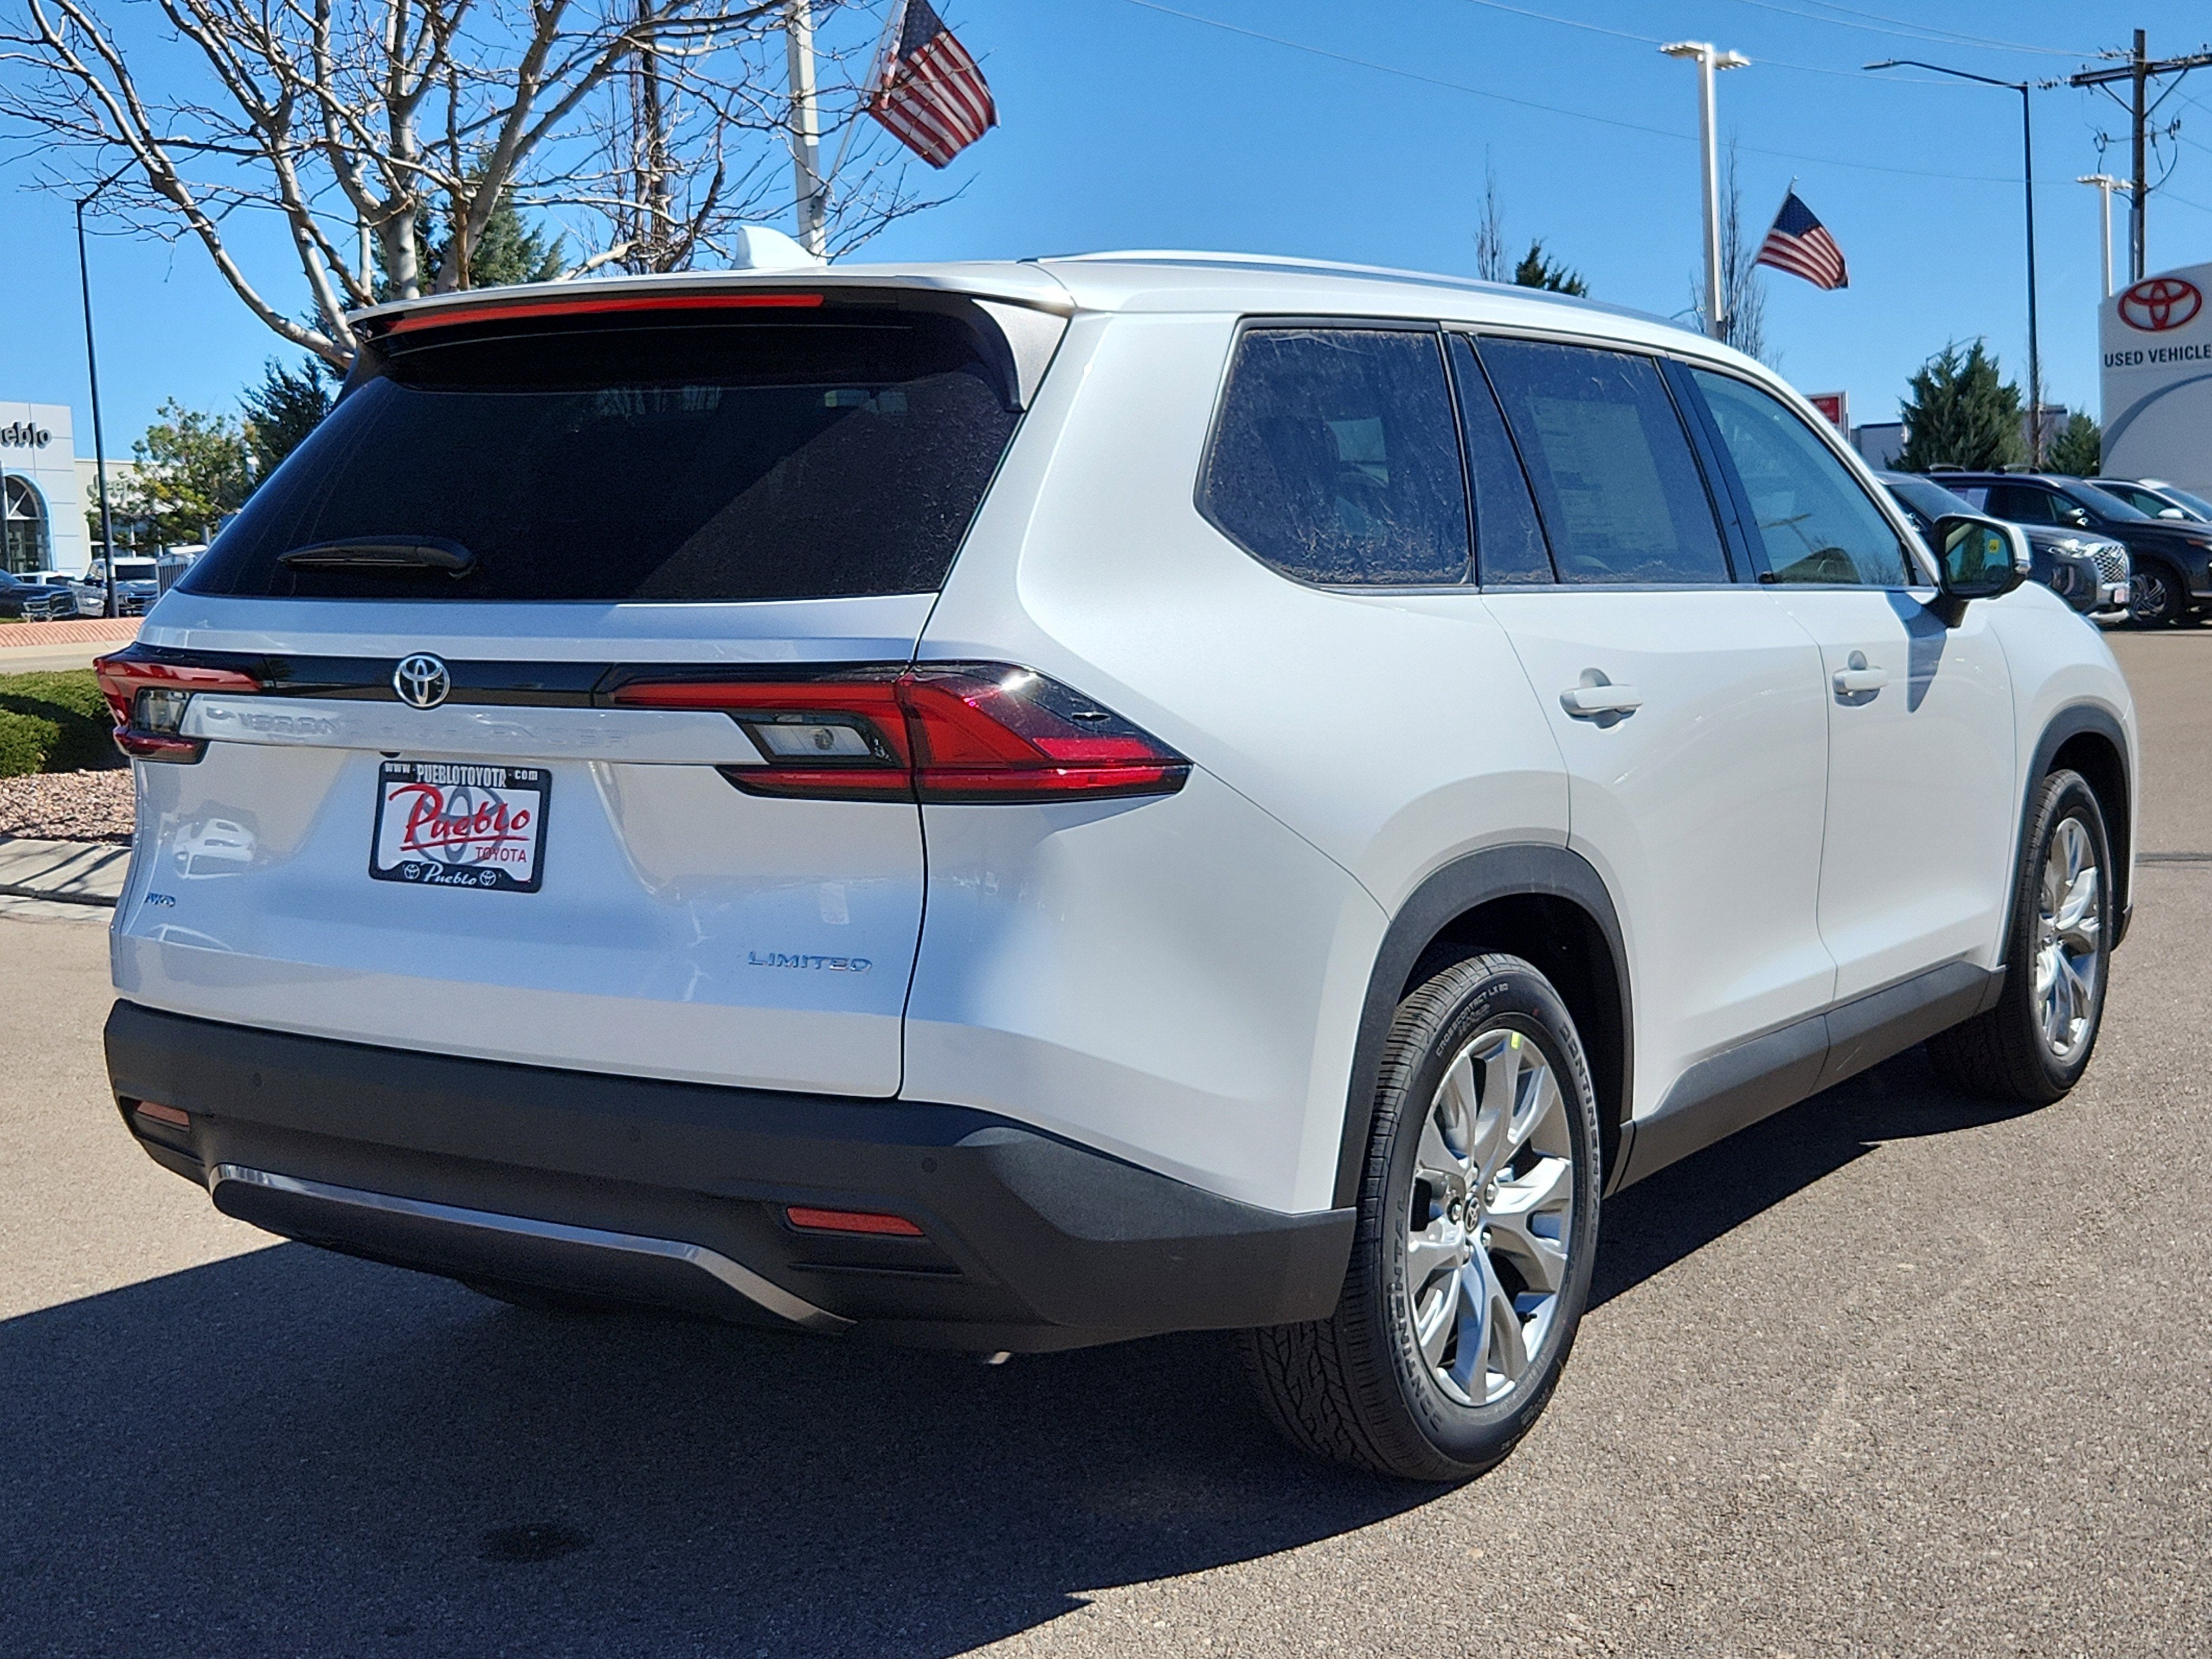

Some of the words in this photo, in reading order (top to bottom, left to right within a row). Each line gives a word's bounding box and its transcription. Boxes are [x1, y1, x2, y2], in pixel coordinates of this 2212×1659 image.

[2104, 350, 2143, 368] USED
[2148, 344, 2211, 363] VEHICLE
[0, 421, 53, 449] eblo
[389, 783, 531, 843] Pueblo
[475, 846, 528, 863] TOYOTA
[420, 861, 478, 885] Pueblo
[748, 951, 873, 972] LIMITED
